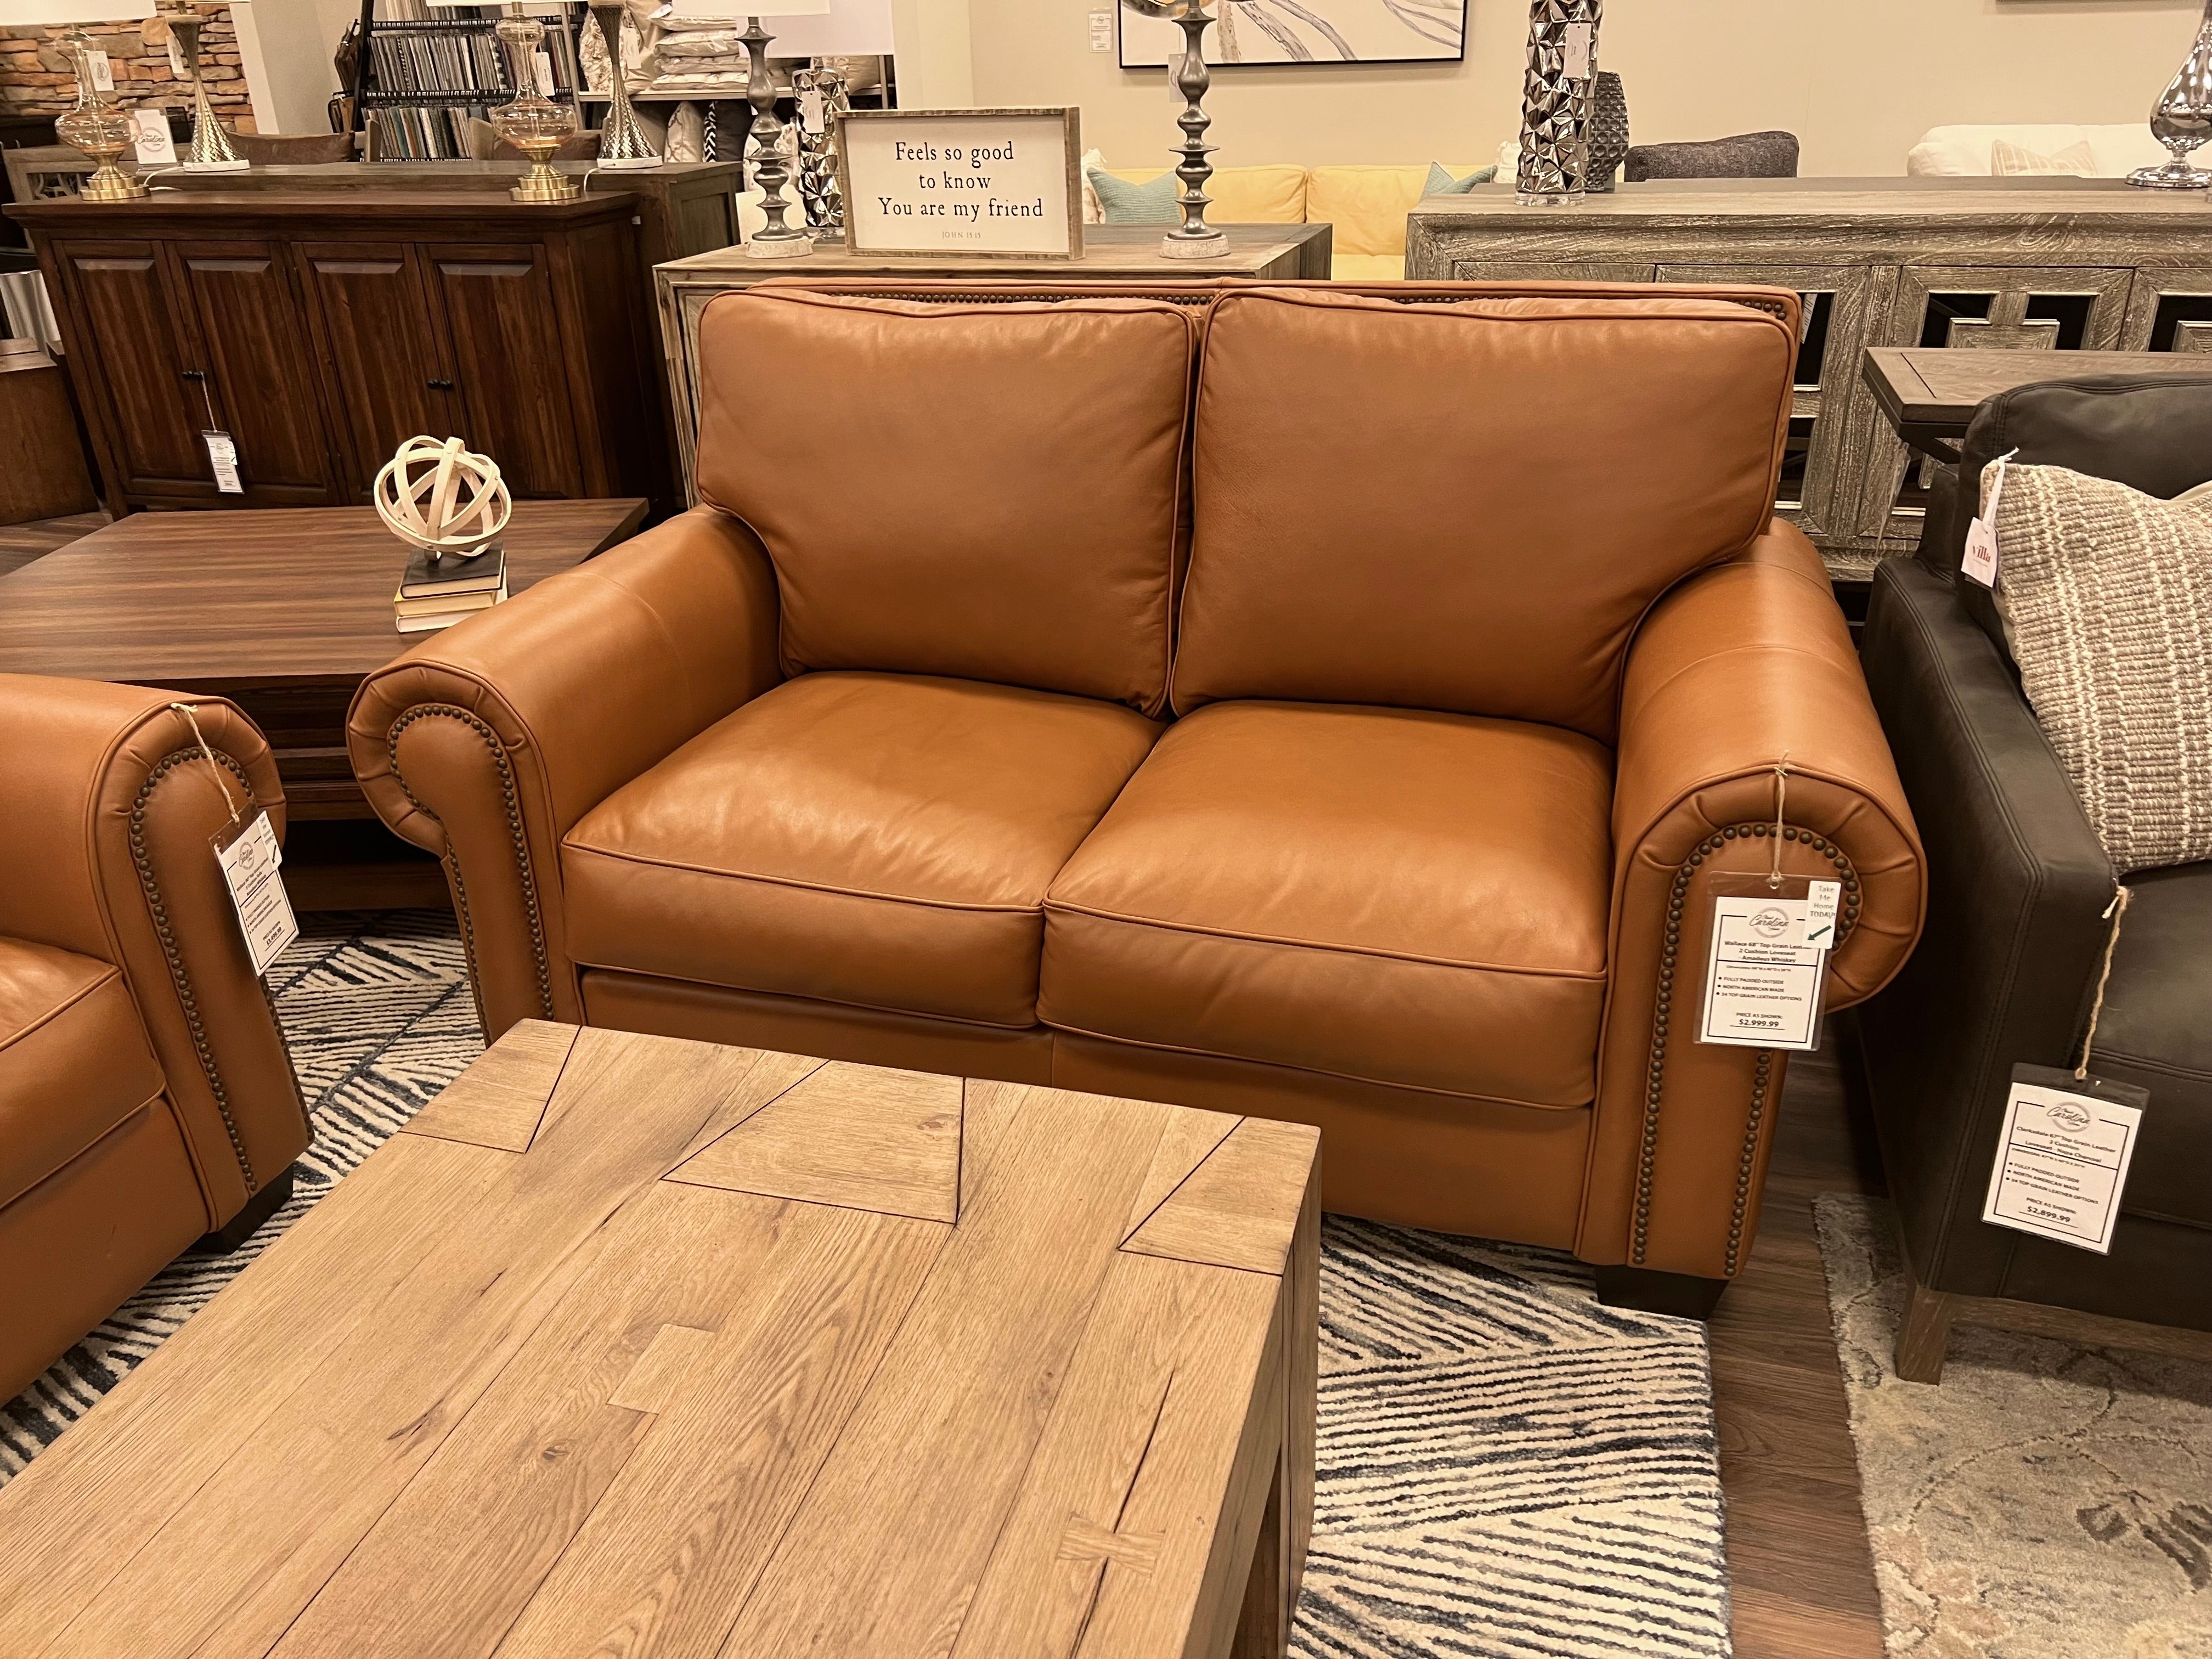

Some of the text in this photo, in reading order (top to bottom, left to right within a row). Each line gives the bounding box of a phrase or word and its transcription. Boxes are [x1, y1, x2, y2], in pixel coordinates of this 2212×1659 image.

[895, 141, 1014, 168] Feels so good
[919, 171, 991, 189] to know
[878, 198, 1043, 222] You are my friend
[1749, 914, 1790, 927] Carolina
[2046, 1105, 2091, 1125] Carolina
[2026, 1197, 2043, 1206] PRICE
[2027, 1206, 2071, 1222] $2,899.99
